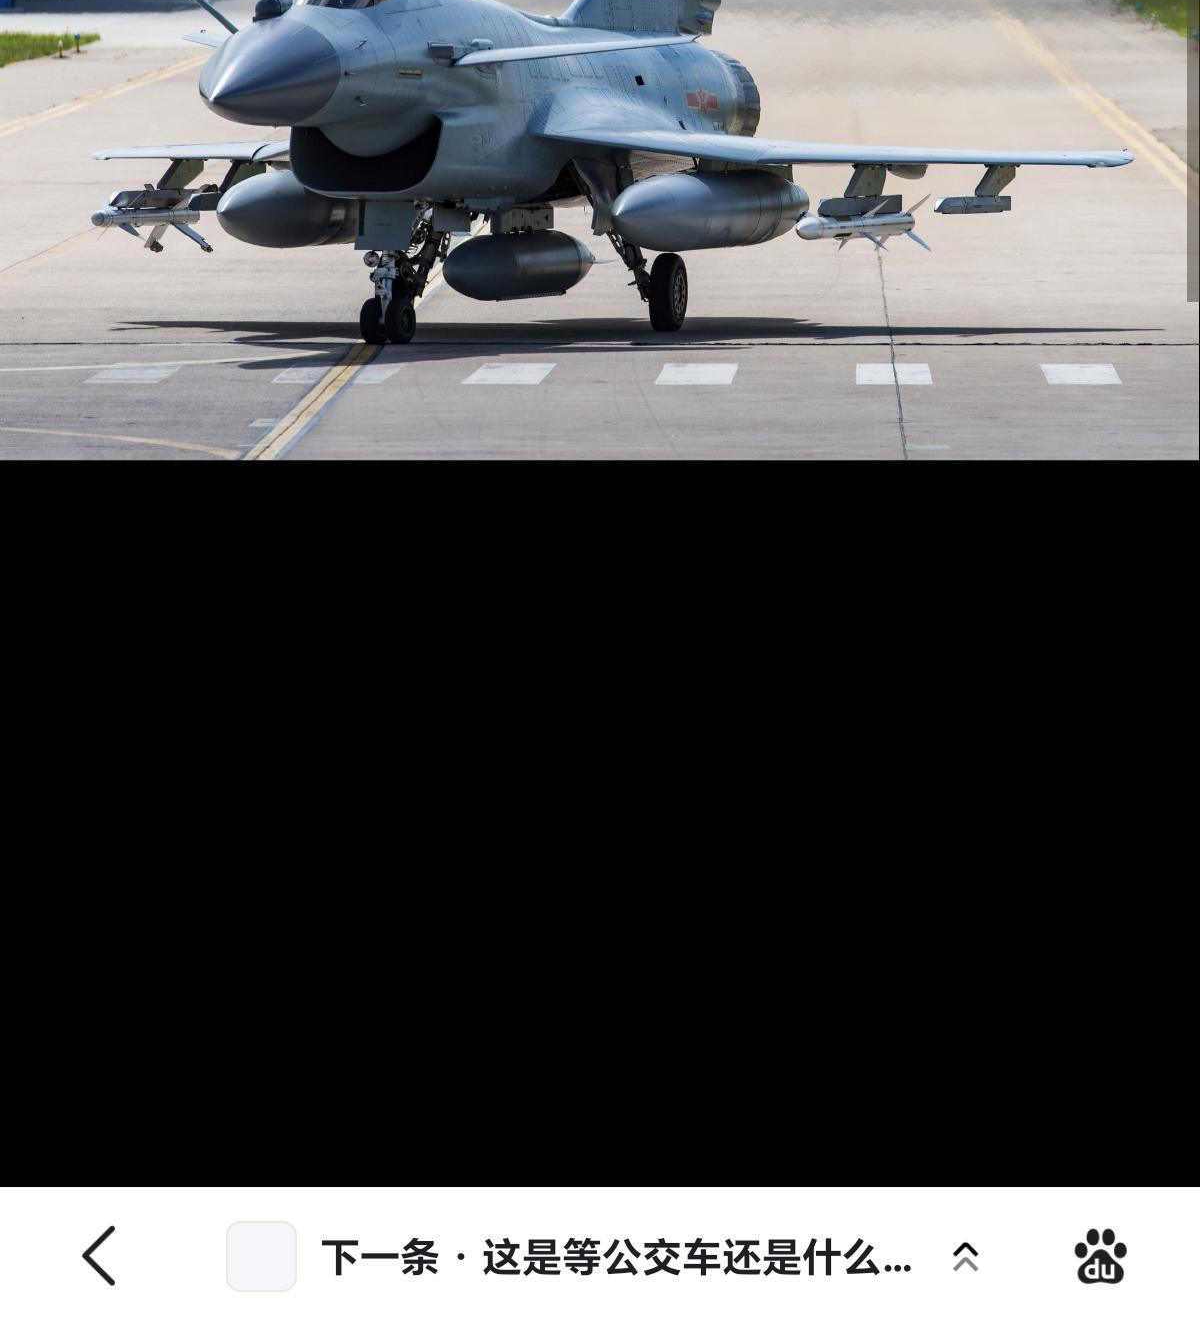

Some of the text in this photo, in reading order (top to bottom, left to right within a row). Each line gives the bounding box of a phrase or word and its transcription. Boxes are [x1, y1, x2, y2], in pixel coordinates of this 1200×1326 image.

[321, 1236, 440, 1277] 下一条
[1084, 1258, 1115, 1279] du
